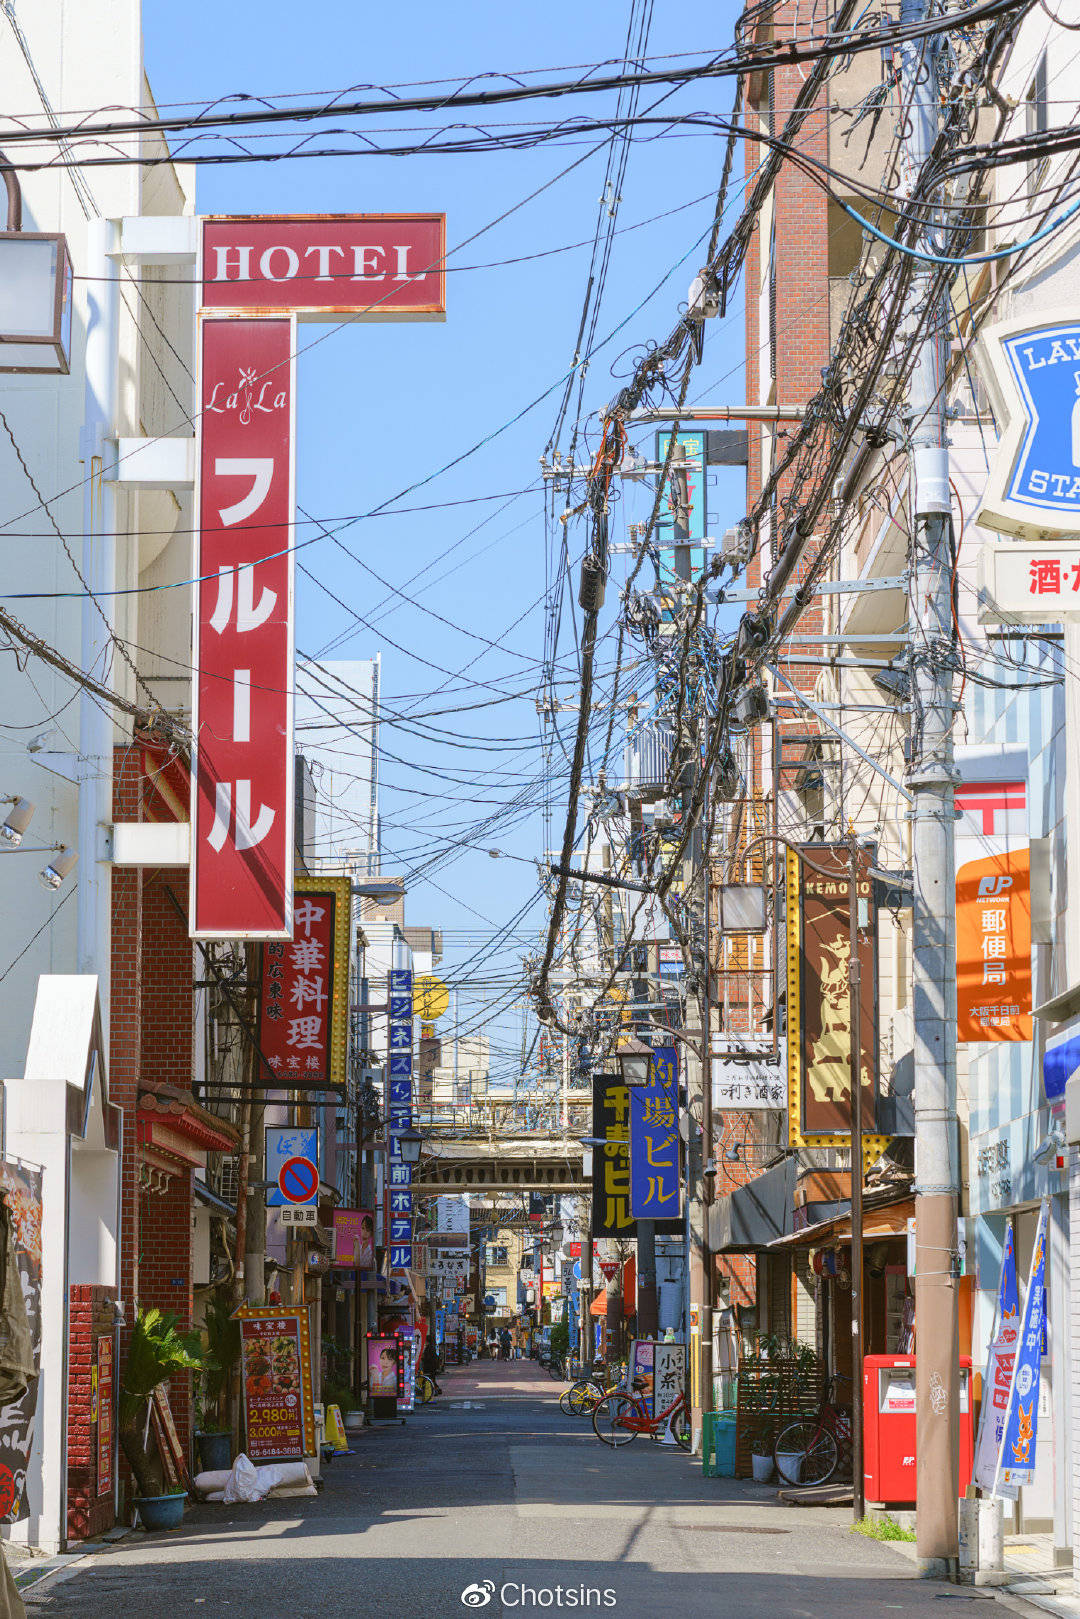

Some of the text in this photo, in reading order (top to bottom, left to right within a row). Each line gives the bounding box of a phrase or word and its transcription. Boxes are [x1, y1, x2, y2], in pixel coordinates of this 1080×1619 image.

[212, 245, 426, 282] HOTEL
[206, 457, 277, 853] フルール
[978, 876, 1013, 895] JP
[981, 909, 1007, 985] 郵便局
[286, 900, 328, 1049] 中華料理
[969, 1005, 1020, 1016] 大阪千日前
[980, 1017, 1010, 1027] 郵便局
[267, 1055, 321, 1069] 味宝楼
[641, 1057, 677, 1206] 的場ビル
[282, 1211, 316, 1222] 自動車
